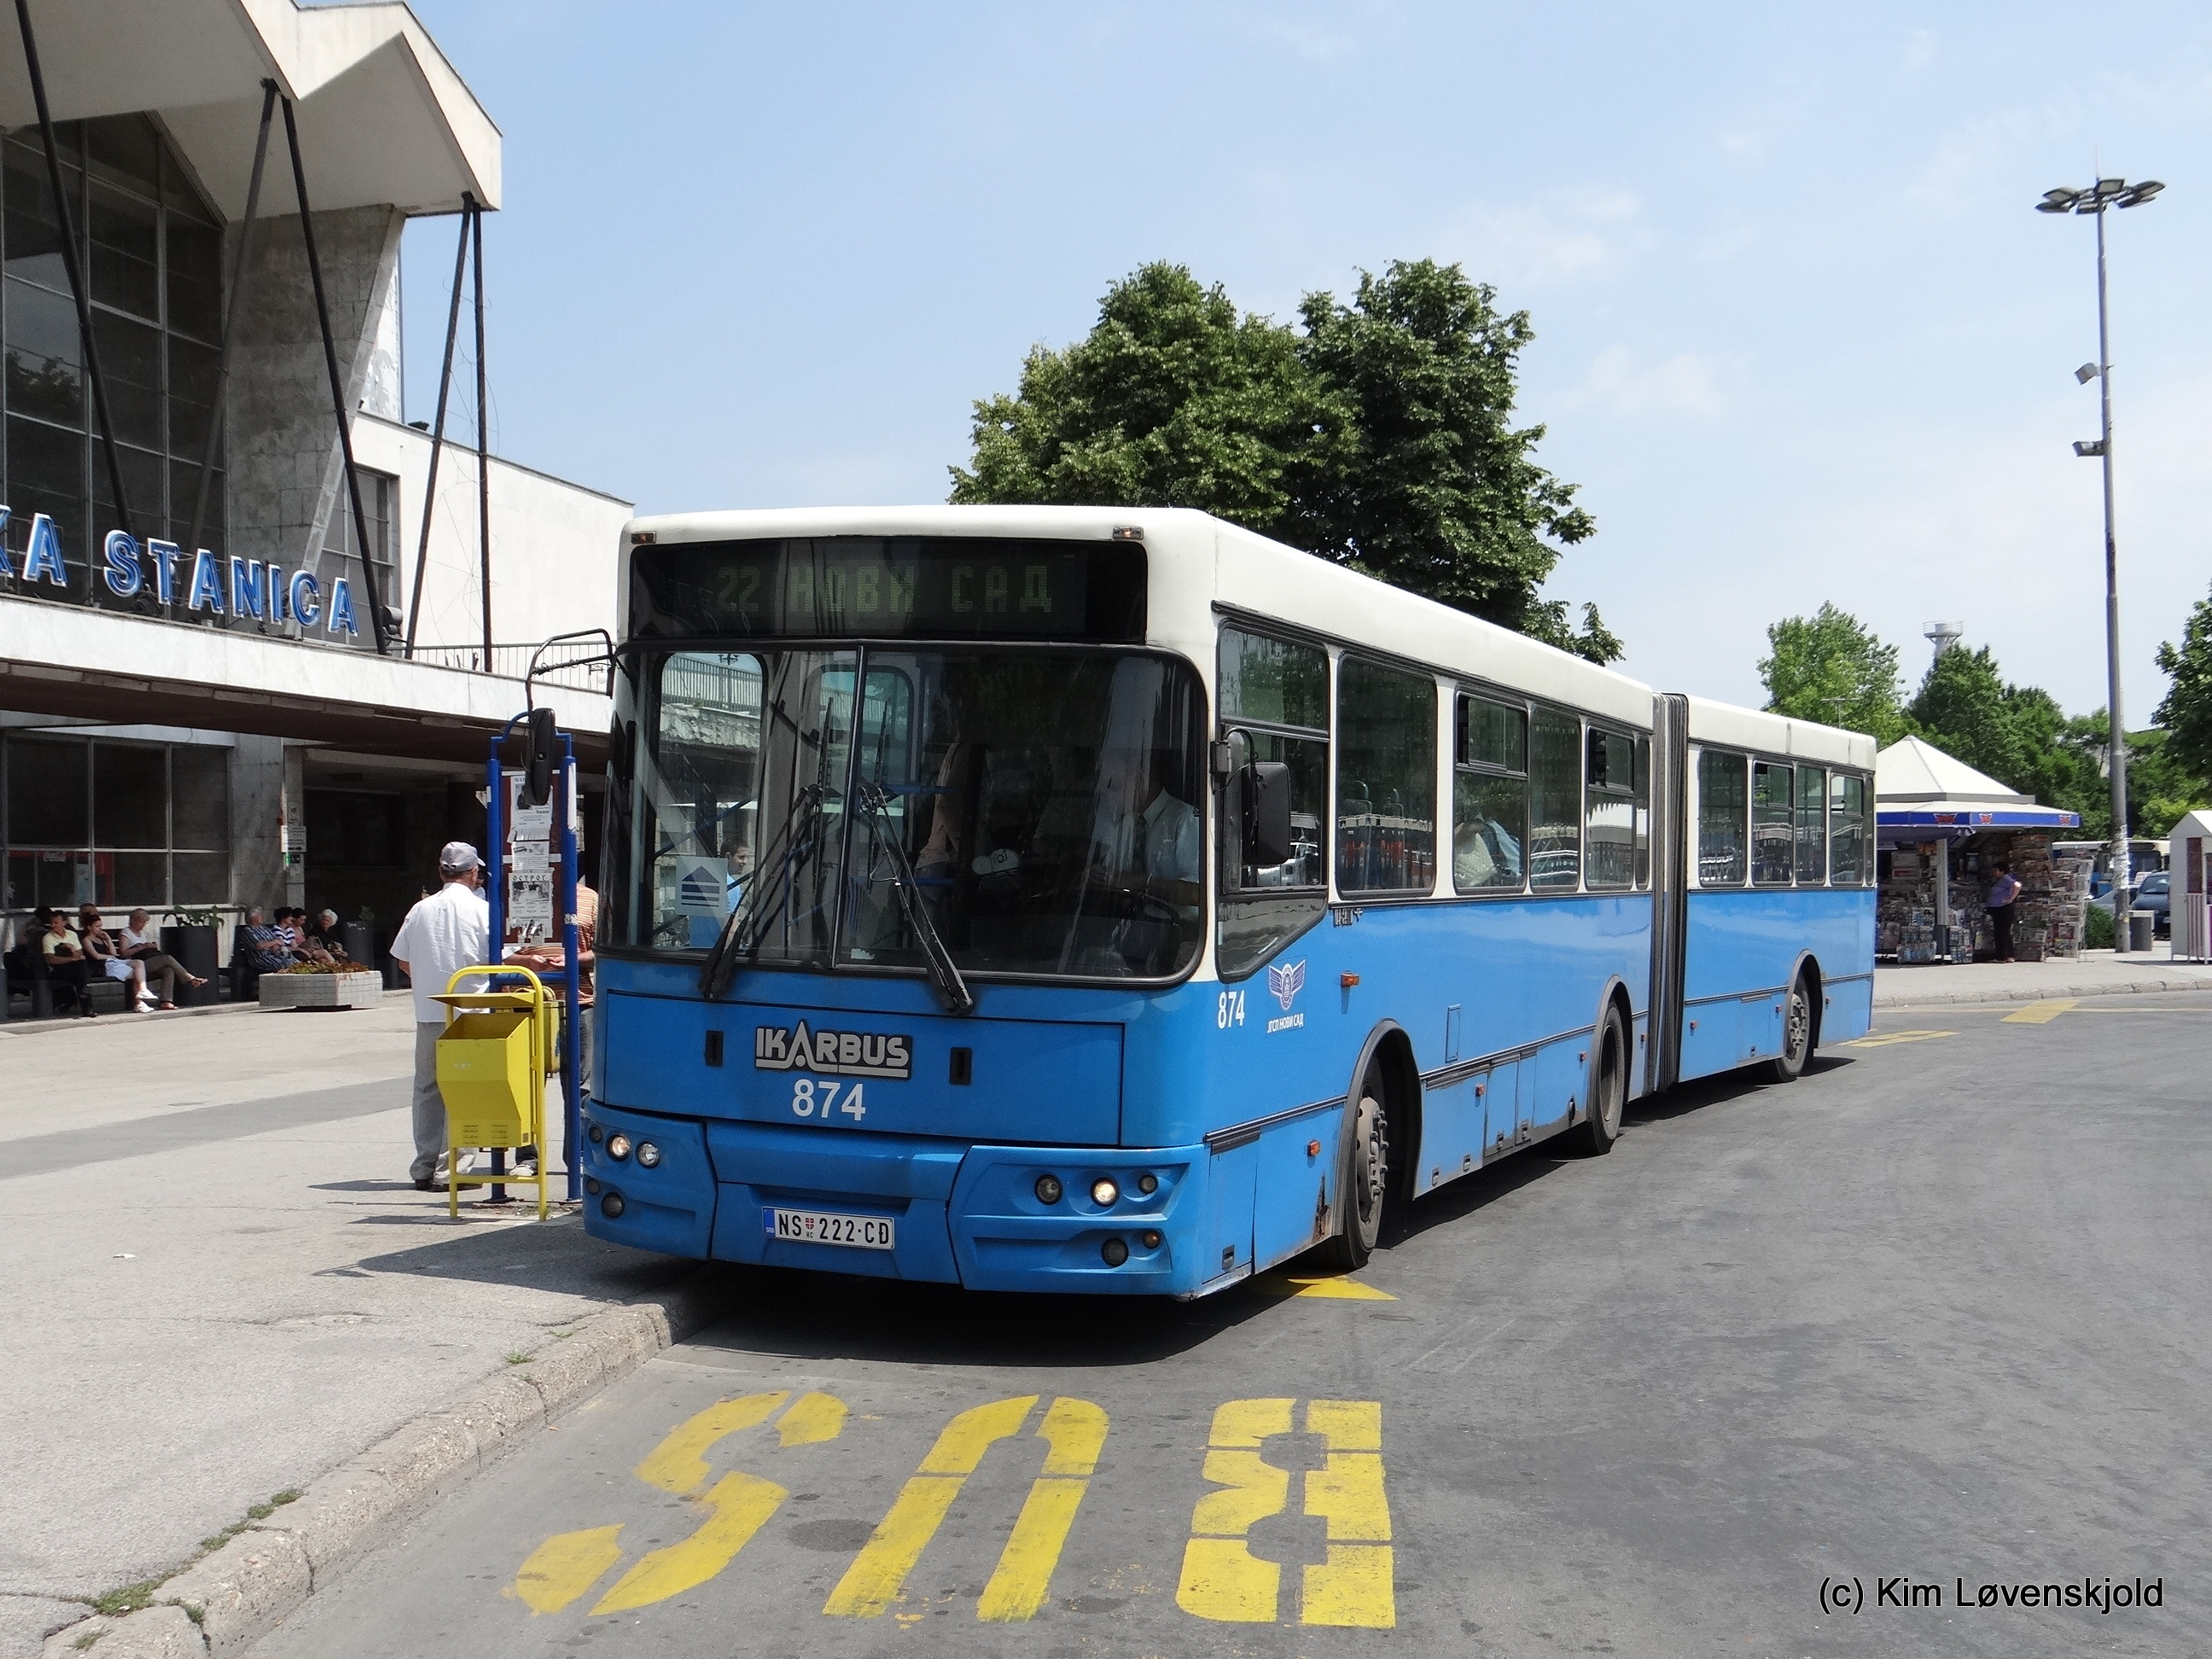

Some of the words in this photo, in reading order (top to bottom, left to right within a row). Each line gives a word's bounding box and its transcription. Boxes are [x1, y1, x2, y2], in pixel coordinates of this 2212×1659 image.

[103, 529, 358, 637] STANICA
[717, 566, 760, 612] 22
[789, 566, 914, 612] НОВИ
[952, 566, 1051, 613] САД
[1218, 990, 1245, 1029] 874
[1279, 1016, 1294, 1030] НОВИ
[1294, 1013, 1304, 1027] САД
[756, 1021, 909, 1077] IKARBUS
[792, 1079, 866, 1121] 874
[778, 1213, 802, 1237] NS
[504, 1391, 1395, 1628] BUS
